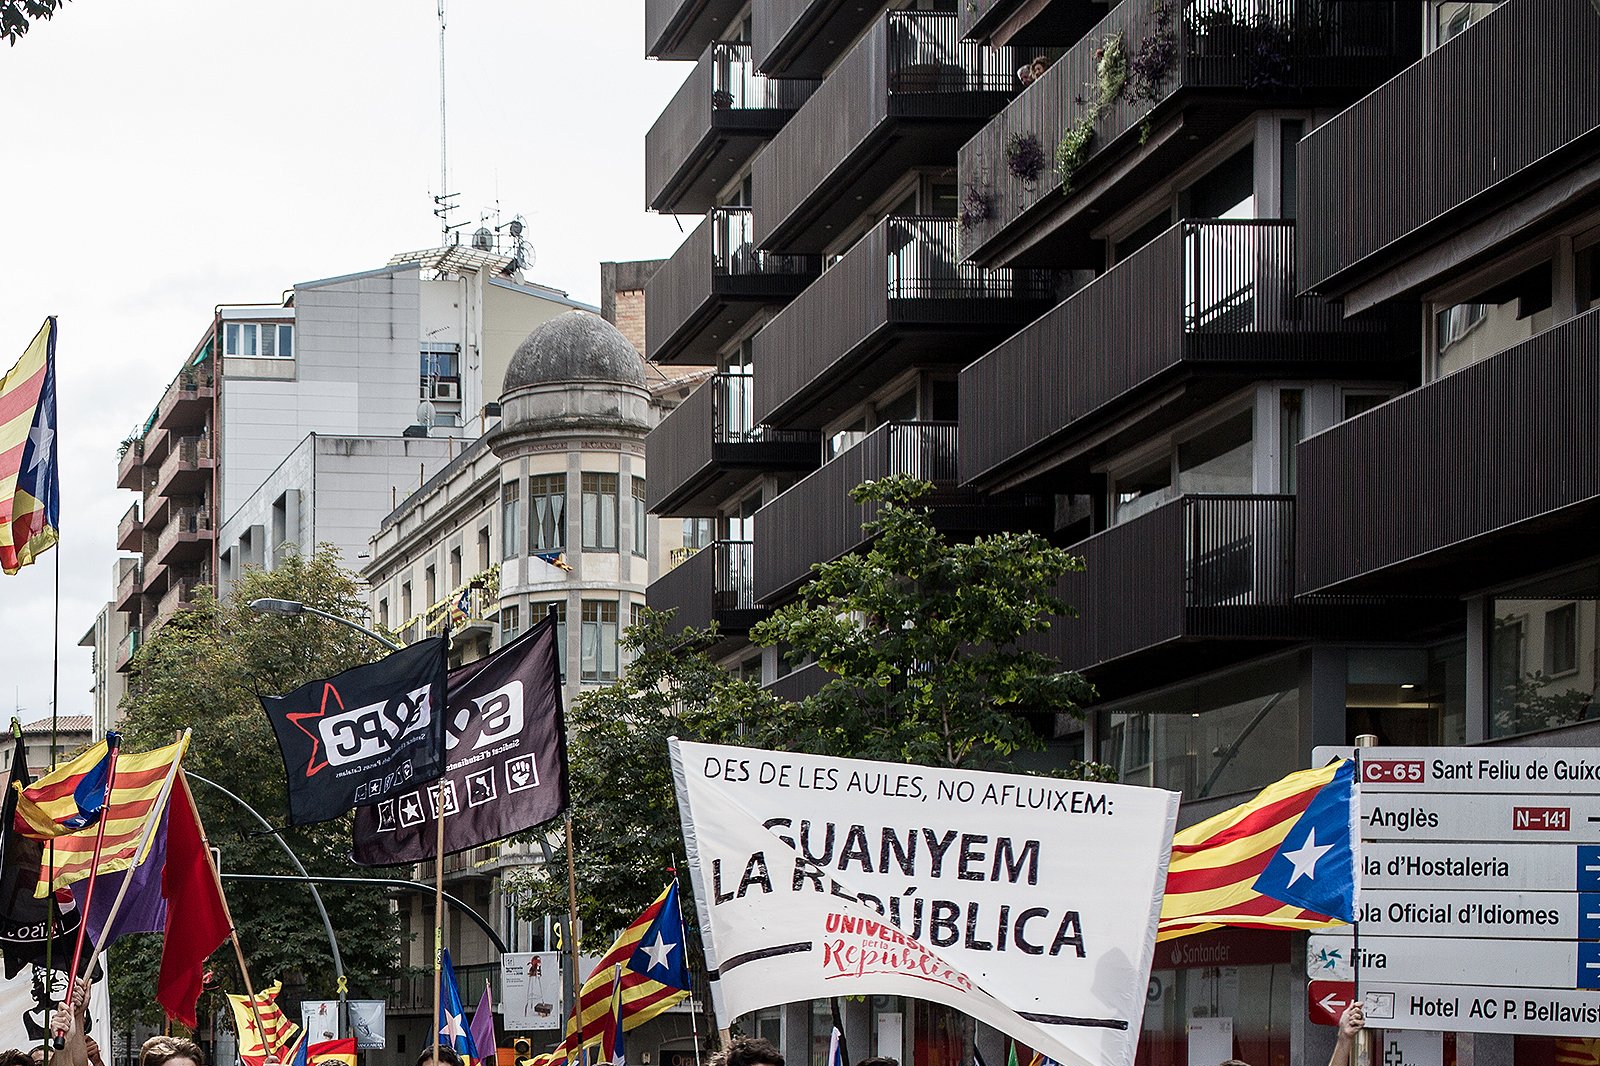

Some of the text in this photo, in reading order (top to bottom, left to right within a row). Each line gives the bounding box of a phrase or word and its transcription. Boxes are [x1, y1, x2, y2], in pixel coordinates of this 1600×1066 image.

[704, 757, 750, 782] DES
[759, 761, 791, 787] DE
[799, 766, 839, 791] LES
[847, 772, 928, 803] AULES,
[937, 778, 974, 803] NO
[1366, 763, 1421, 780] C-65
[1432, 760, 1472, 780] Sant
[1479, 760, 1519, 780] Feliu
[1526, 760, 1548, 780] de
[1517, 811, 1567, 828] N-141
[762, 817, 1040, 886] GUANYEM
[1387, 856, 1509, 877] d'Hostaleria
[712, 851, 773, 906] LA
[1388, 903, 1452, 923] Oficial
[1458, 904, 1559, 925] d'Idiomes
[1183, 942, 1231, 964] Santander
[1350, 948, 1387, 968] Fira
[823, 939, 972, 990] República
[1410, 996, 1459, 1018] Hotel
[1469, 998, 1498, 1019] AC
[1503, 999, 1517, 1020] P.
